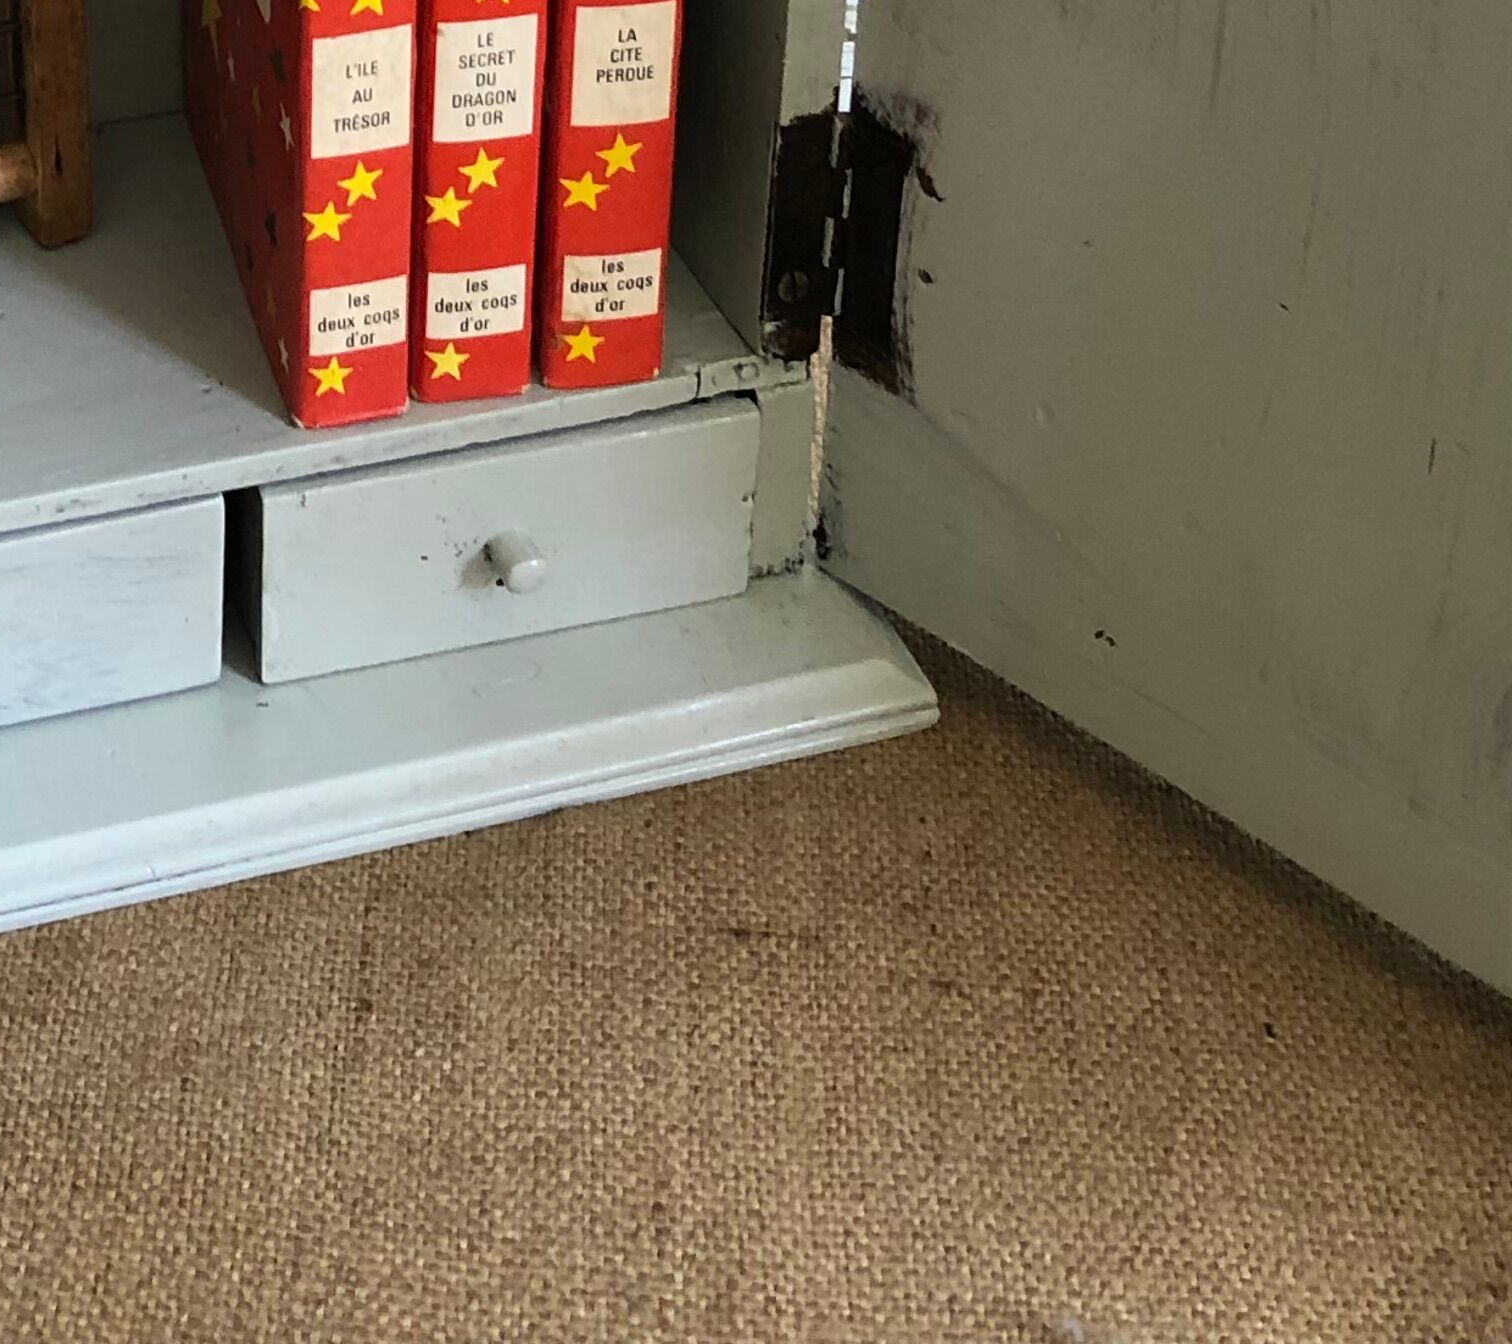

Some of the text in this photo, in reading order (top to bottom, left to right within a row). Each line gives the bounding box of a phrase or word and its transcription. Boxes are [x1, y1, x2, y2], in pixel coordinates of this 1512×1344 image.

[477, 31, 494, 48] LE
[618, 27, 637, 43] LA
[458, 49, 516, 70] SECRET
[476, 71, 497, 88] DU
[596, 64, 654, 84] PERDUE
[352, 87, 373, 104] AU
[451, 89, 517, 109] DRAGON
[465, 110, 503, 127] D'OR
[601, 257, 624, 274] les
[466, 276, 488, 293] les
[570, 275, 654, 295] deux coqs
[347, 291, 370, 308] les
[434, 293, 518, 314] deux coqs
[595, 296, 625, 313] d'or
[317, 307, 400, 333] deux coqs
[460, 315, 490, 333] d'or
[345, 329, 375, 348] d'or
